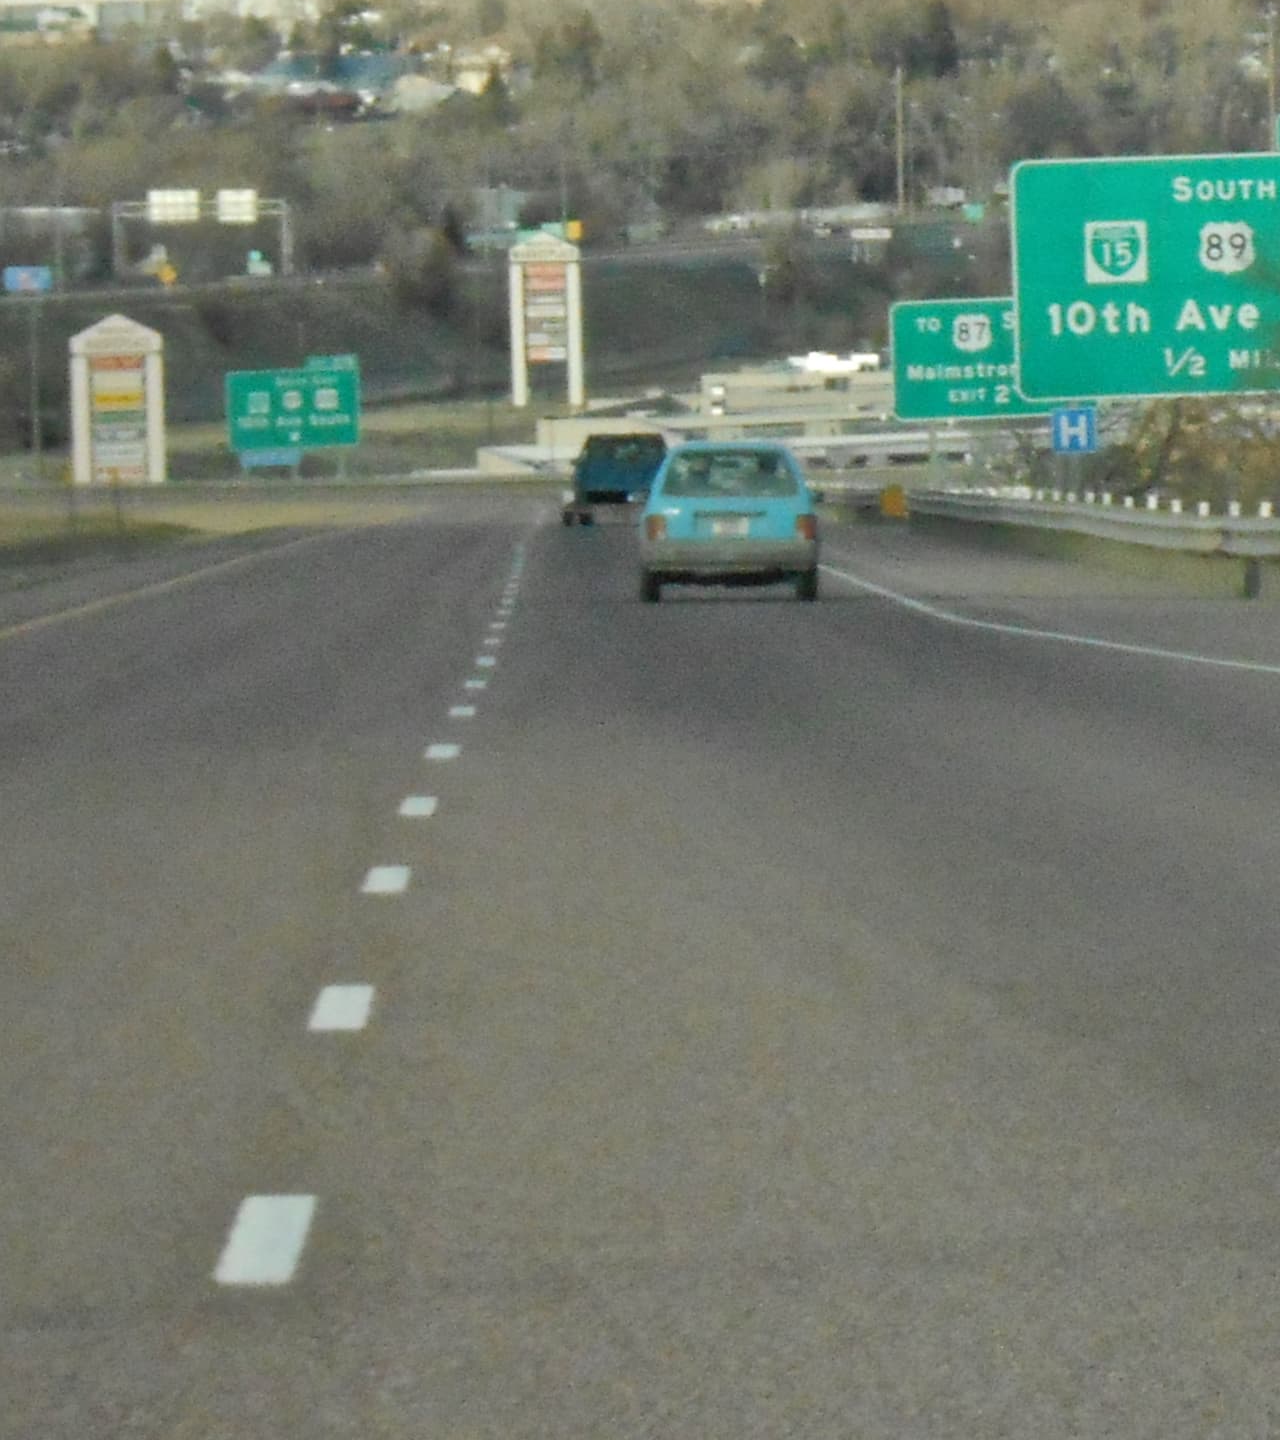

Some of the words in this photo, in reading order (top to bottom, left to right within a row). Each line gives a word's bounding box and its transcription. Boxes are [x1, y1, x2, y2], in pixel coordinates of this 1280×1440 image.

[1173, 175, 1276, 201] SOUTH
[1102, 240, 1134, 267] 15
[1206, 233, 1246, 261] 89
[1048, 300, 1149, 335] 10th
[1176, 299, 1260, 330] Ave
[957, 322, 986, 342] 87
[1060, 415, 1088, 448] H
